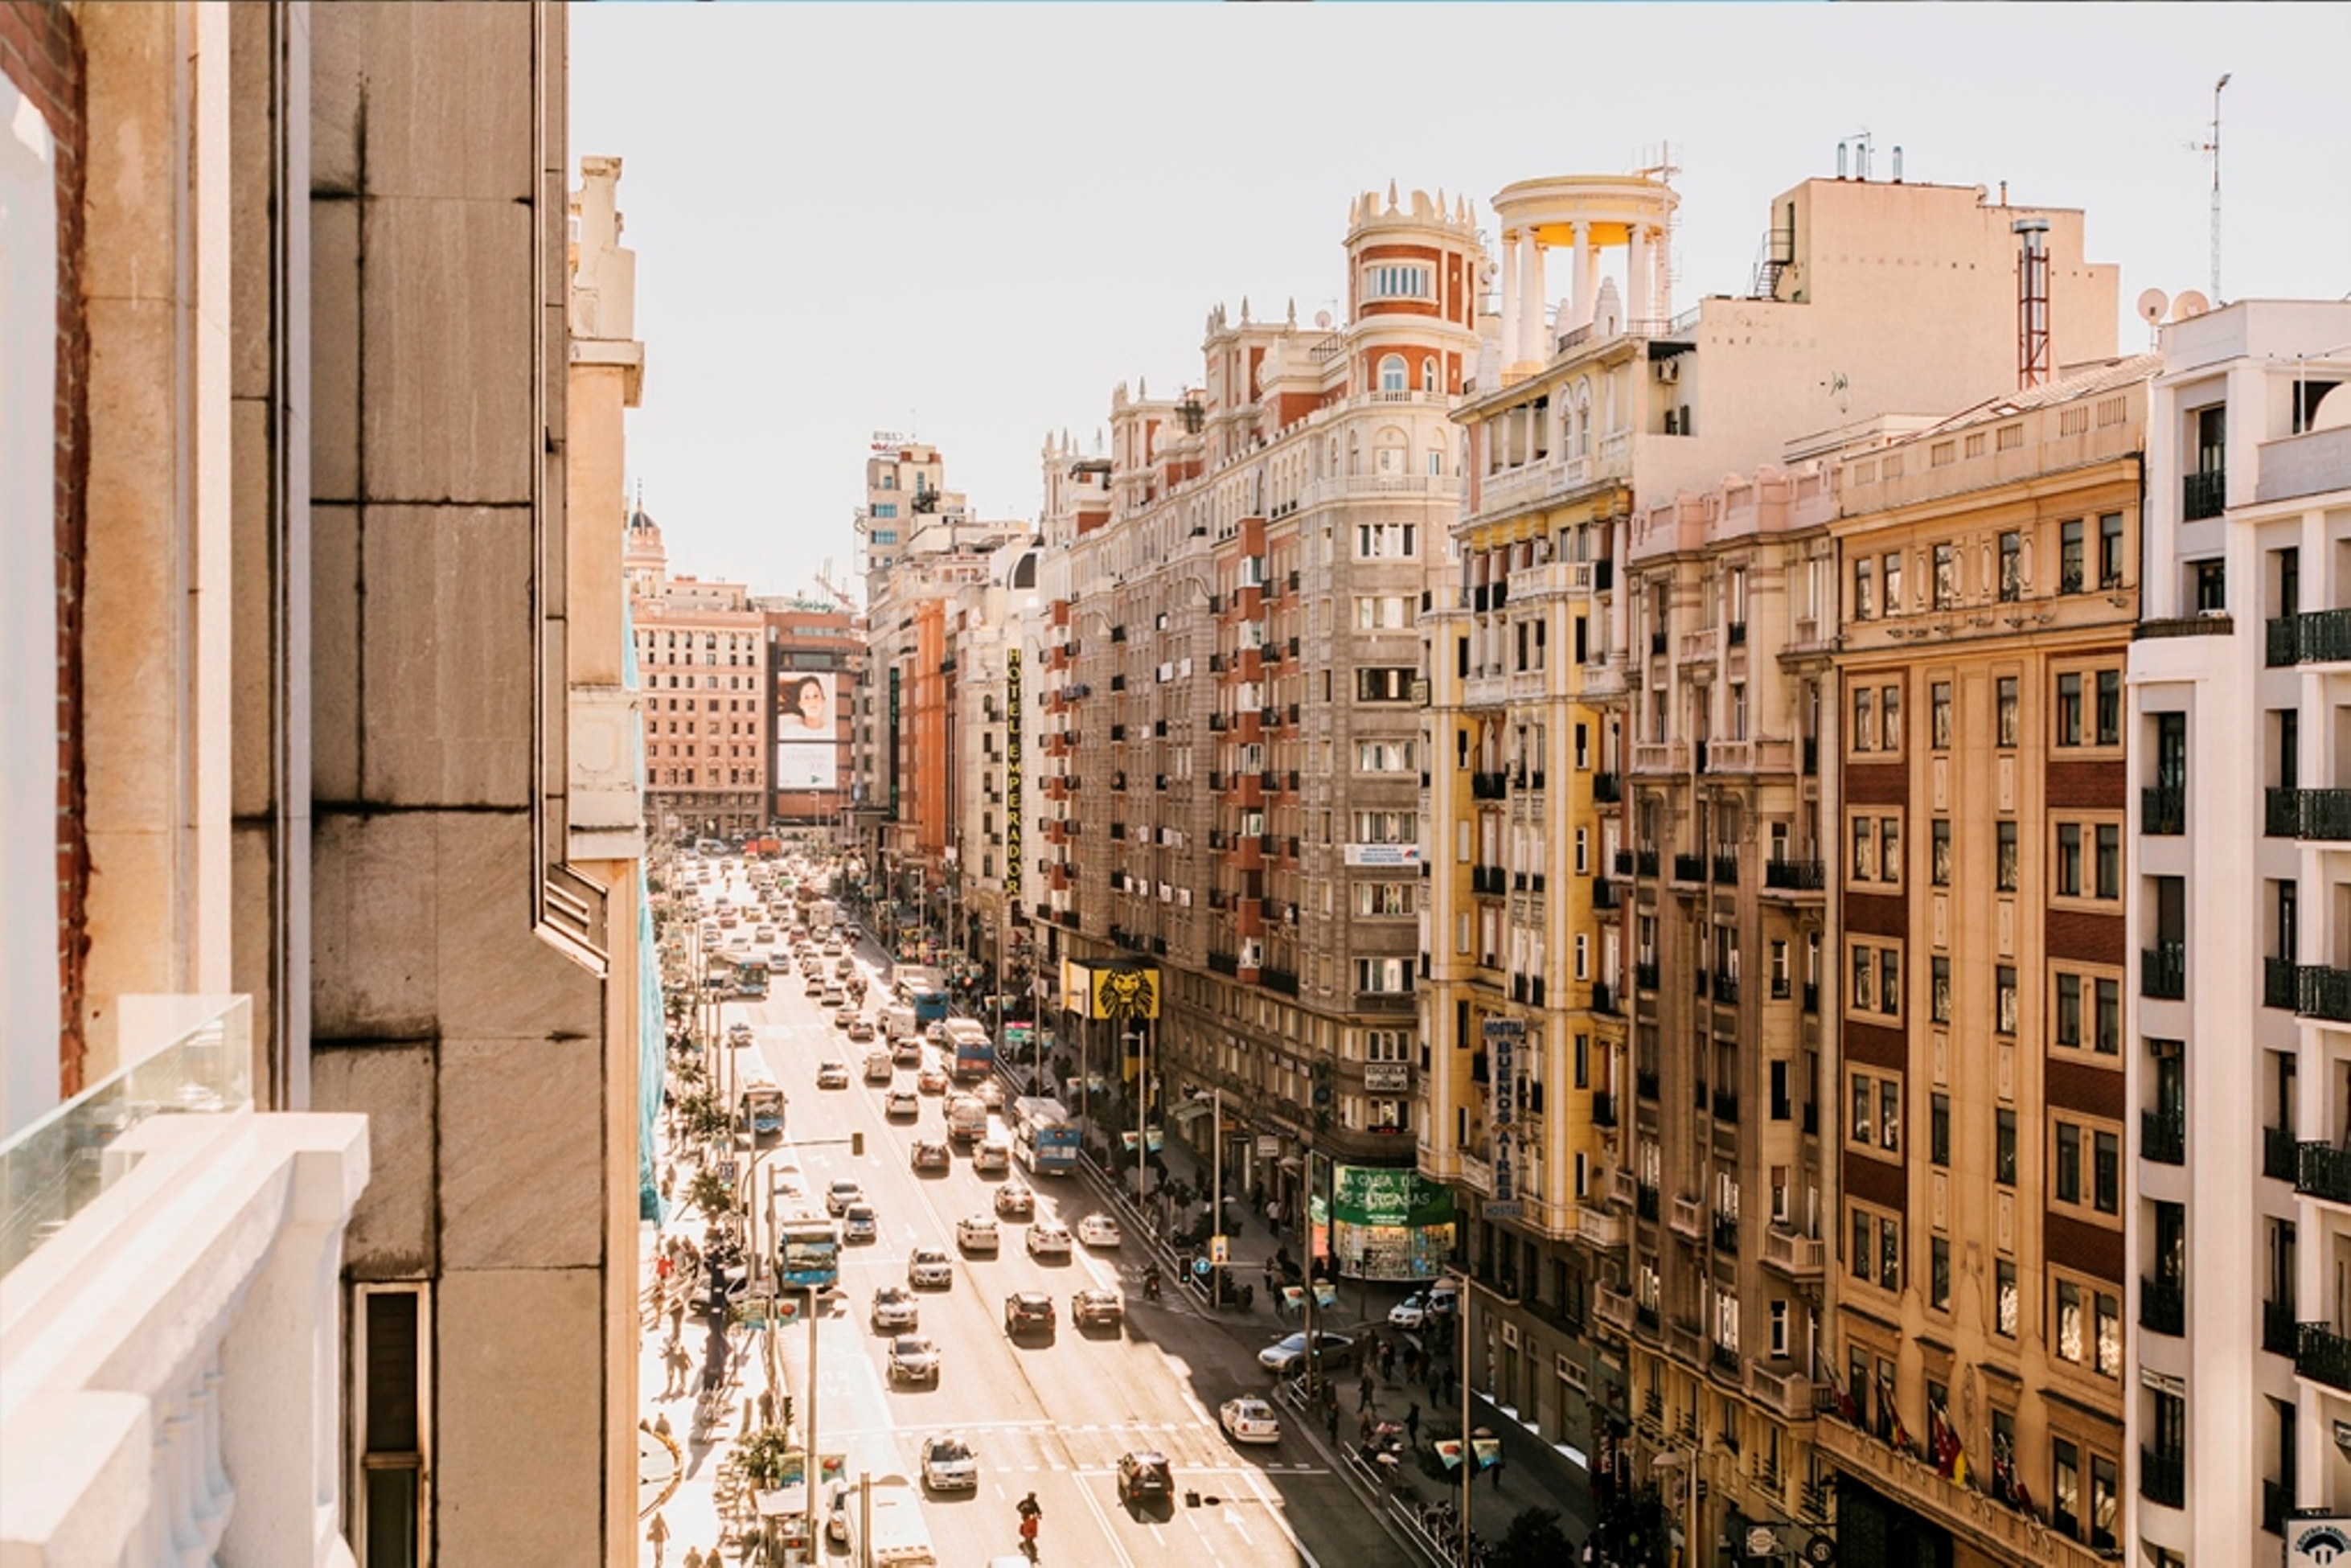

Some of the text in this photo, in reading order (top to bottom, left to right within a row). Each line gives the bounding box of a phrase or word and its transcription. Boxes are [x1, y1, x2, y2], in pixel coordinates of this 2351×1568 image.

[1007, 649, 1022, 896] HOTEL EMPERADOR
[1485, 1021, 1523, 1035] HOSTAL
[1497, 1041, 1512, 1200] BUENOS AIRES
